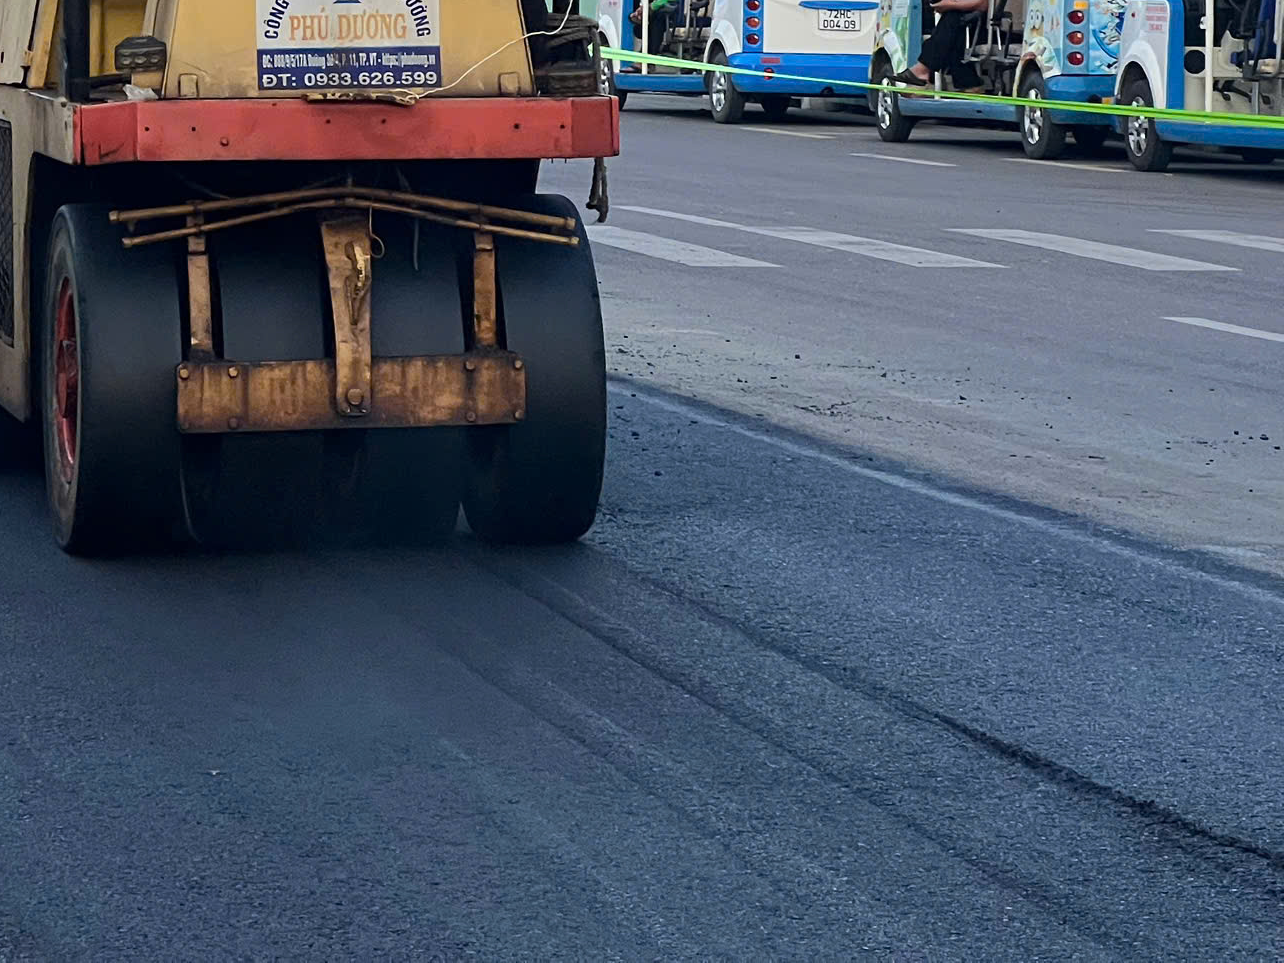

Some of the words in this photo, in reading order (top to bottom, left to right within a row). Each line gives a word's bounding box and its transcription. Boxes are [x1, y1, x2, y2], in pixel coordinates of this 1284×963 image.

[288, 6, 329, 41] PHÚ
[262, 73, 297, 87] ĐT:
[304, 71, 437, 87] 0933.626.599
